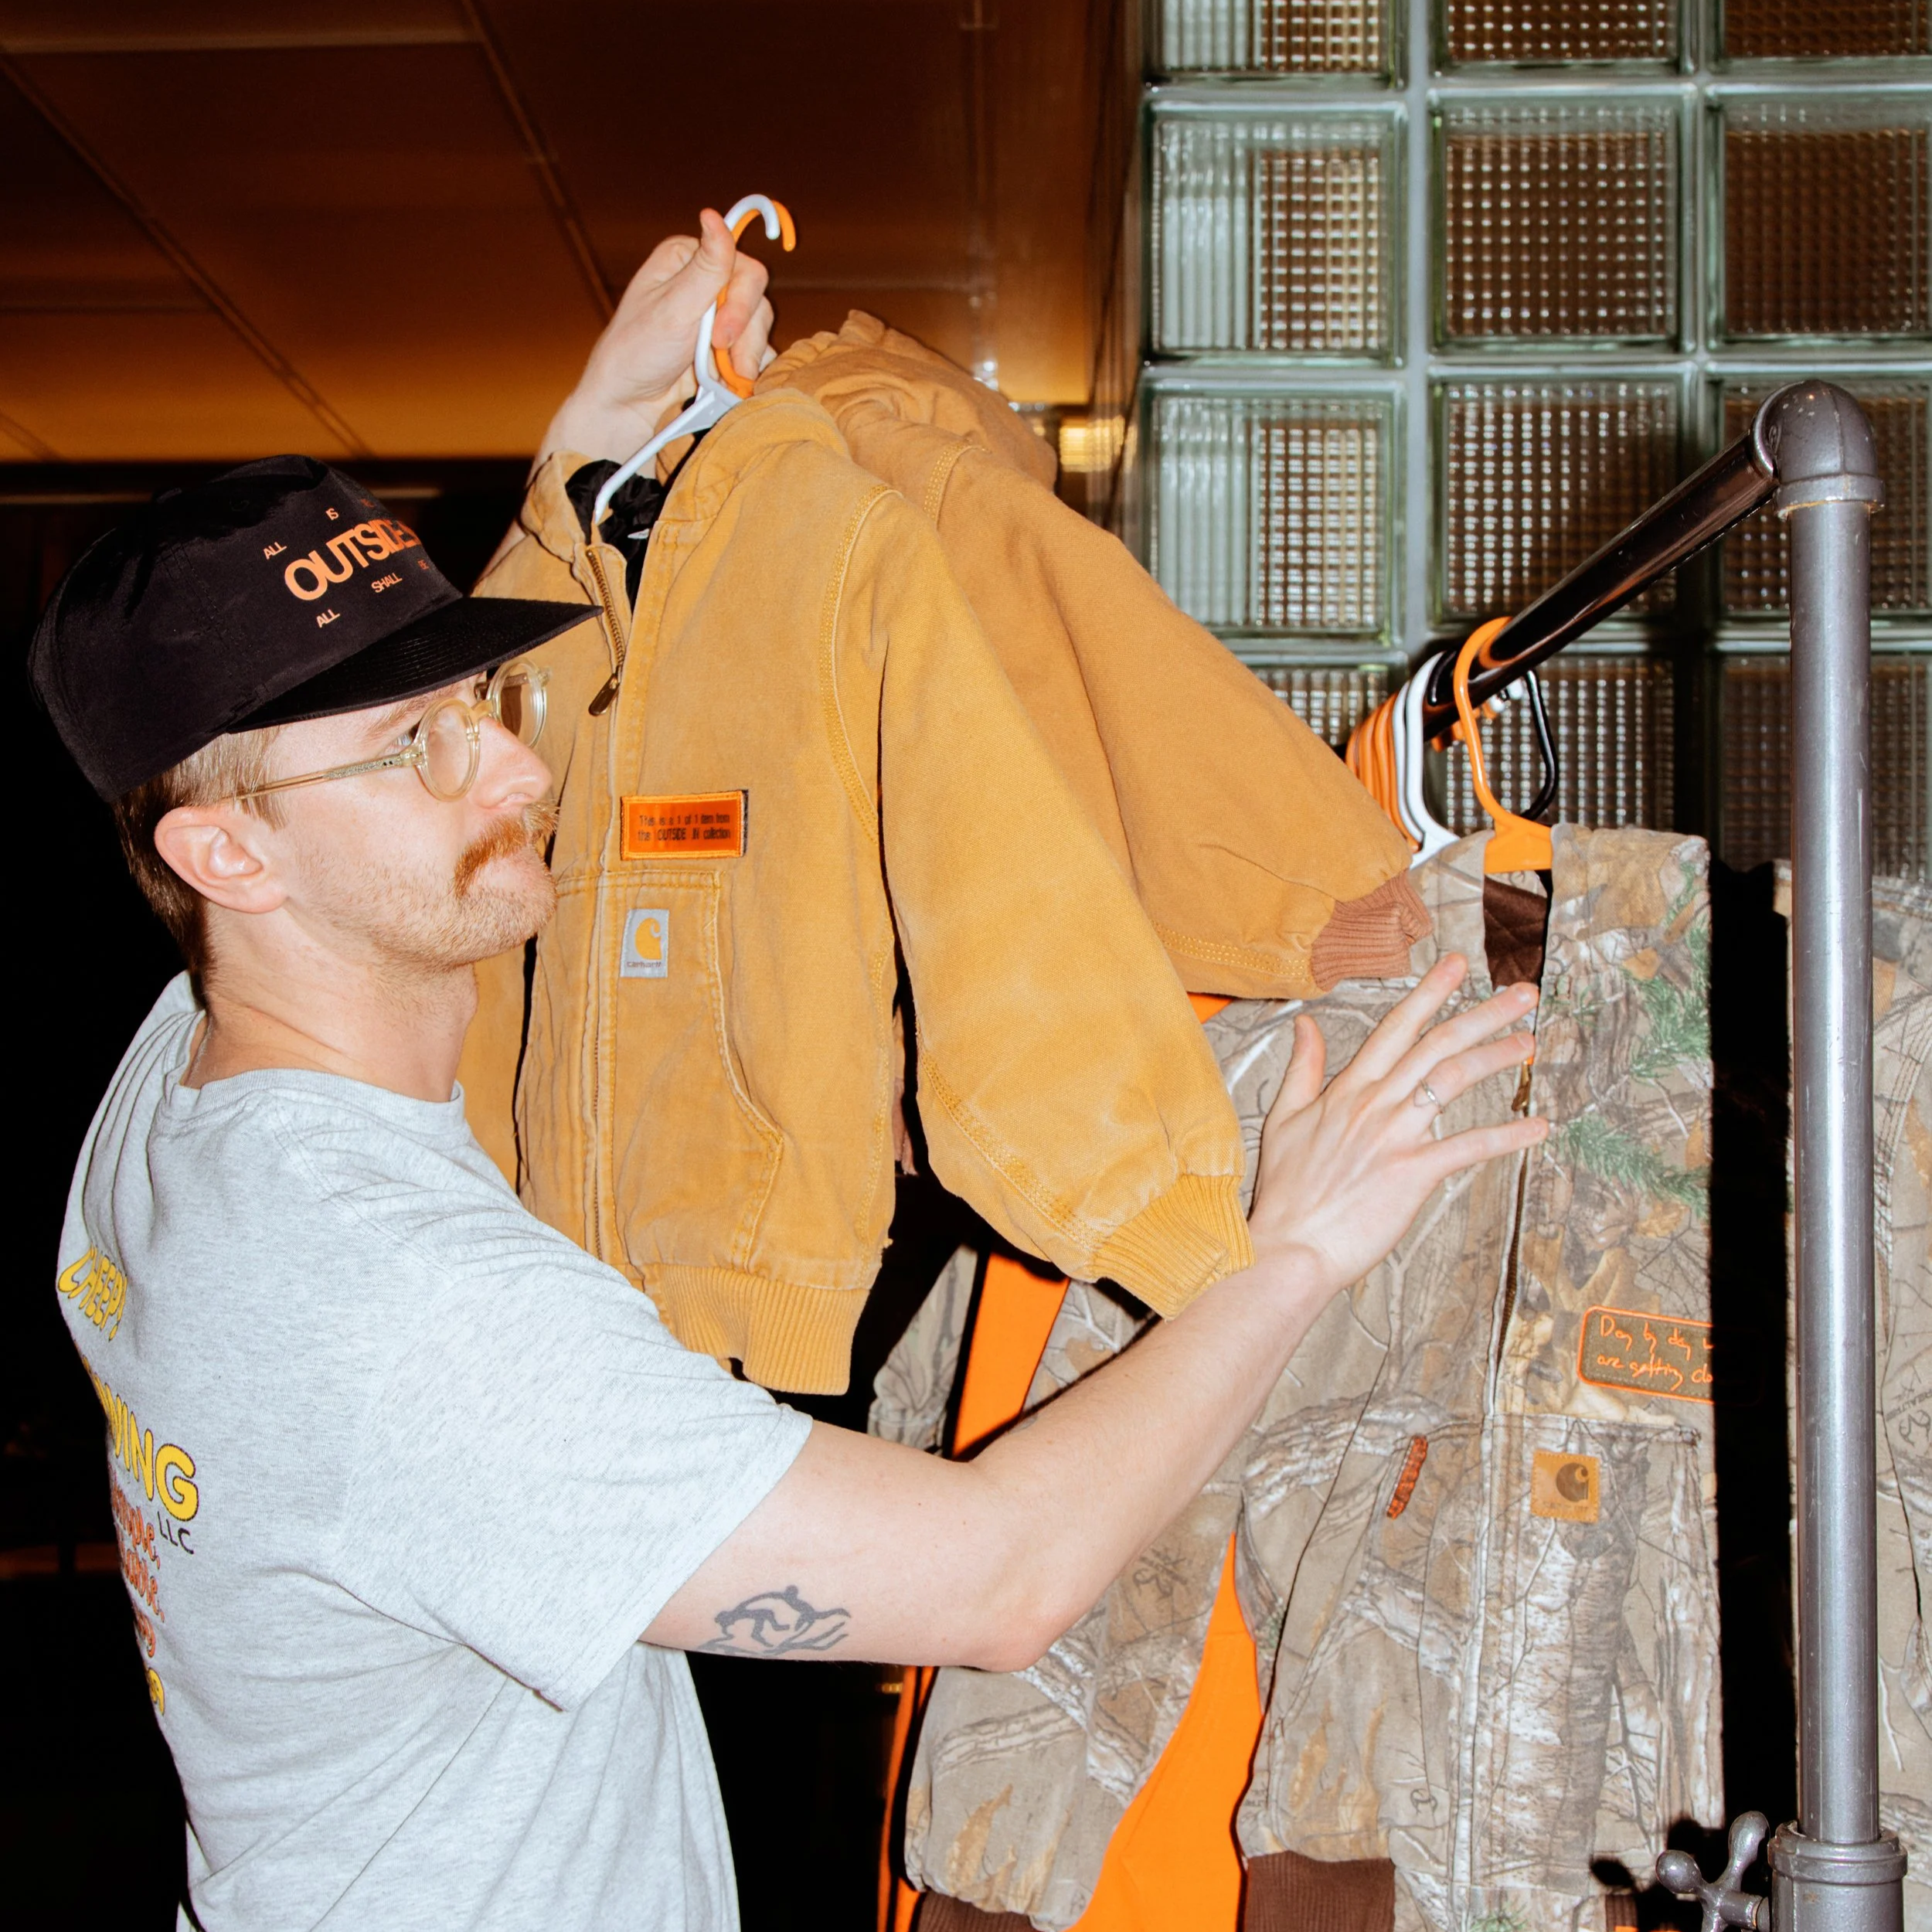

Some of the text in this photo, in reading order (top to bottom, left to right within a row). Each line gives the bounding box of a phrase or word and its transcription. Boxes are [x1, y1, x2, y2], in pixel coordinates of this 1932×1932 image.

[263, 508, 339, 560] ALL IS
[284, 519, 422, 601] OUTSIDE
[316, 609, 341, 628] ALL
[371, 573, 403, 593] SHALL
[638, 830, 651, 841] the
[658, 828, 686, 841] OUTSIDE
[703, 827, 730, 840] collection
[639, 815, 655, 826] This
[1600, 1315, 1692, 1362] Day by day
[1597, 1355, 1625, 1369] are
[158, 1511, 194, 1554] LLC
